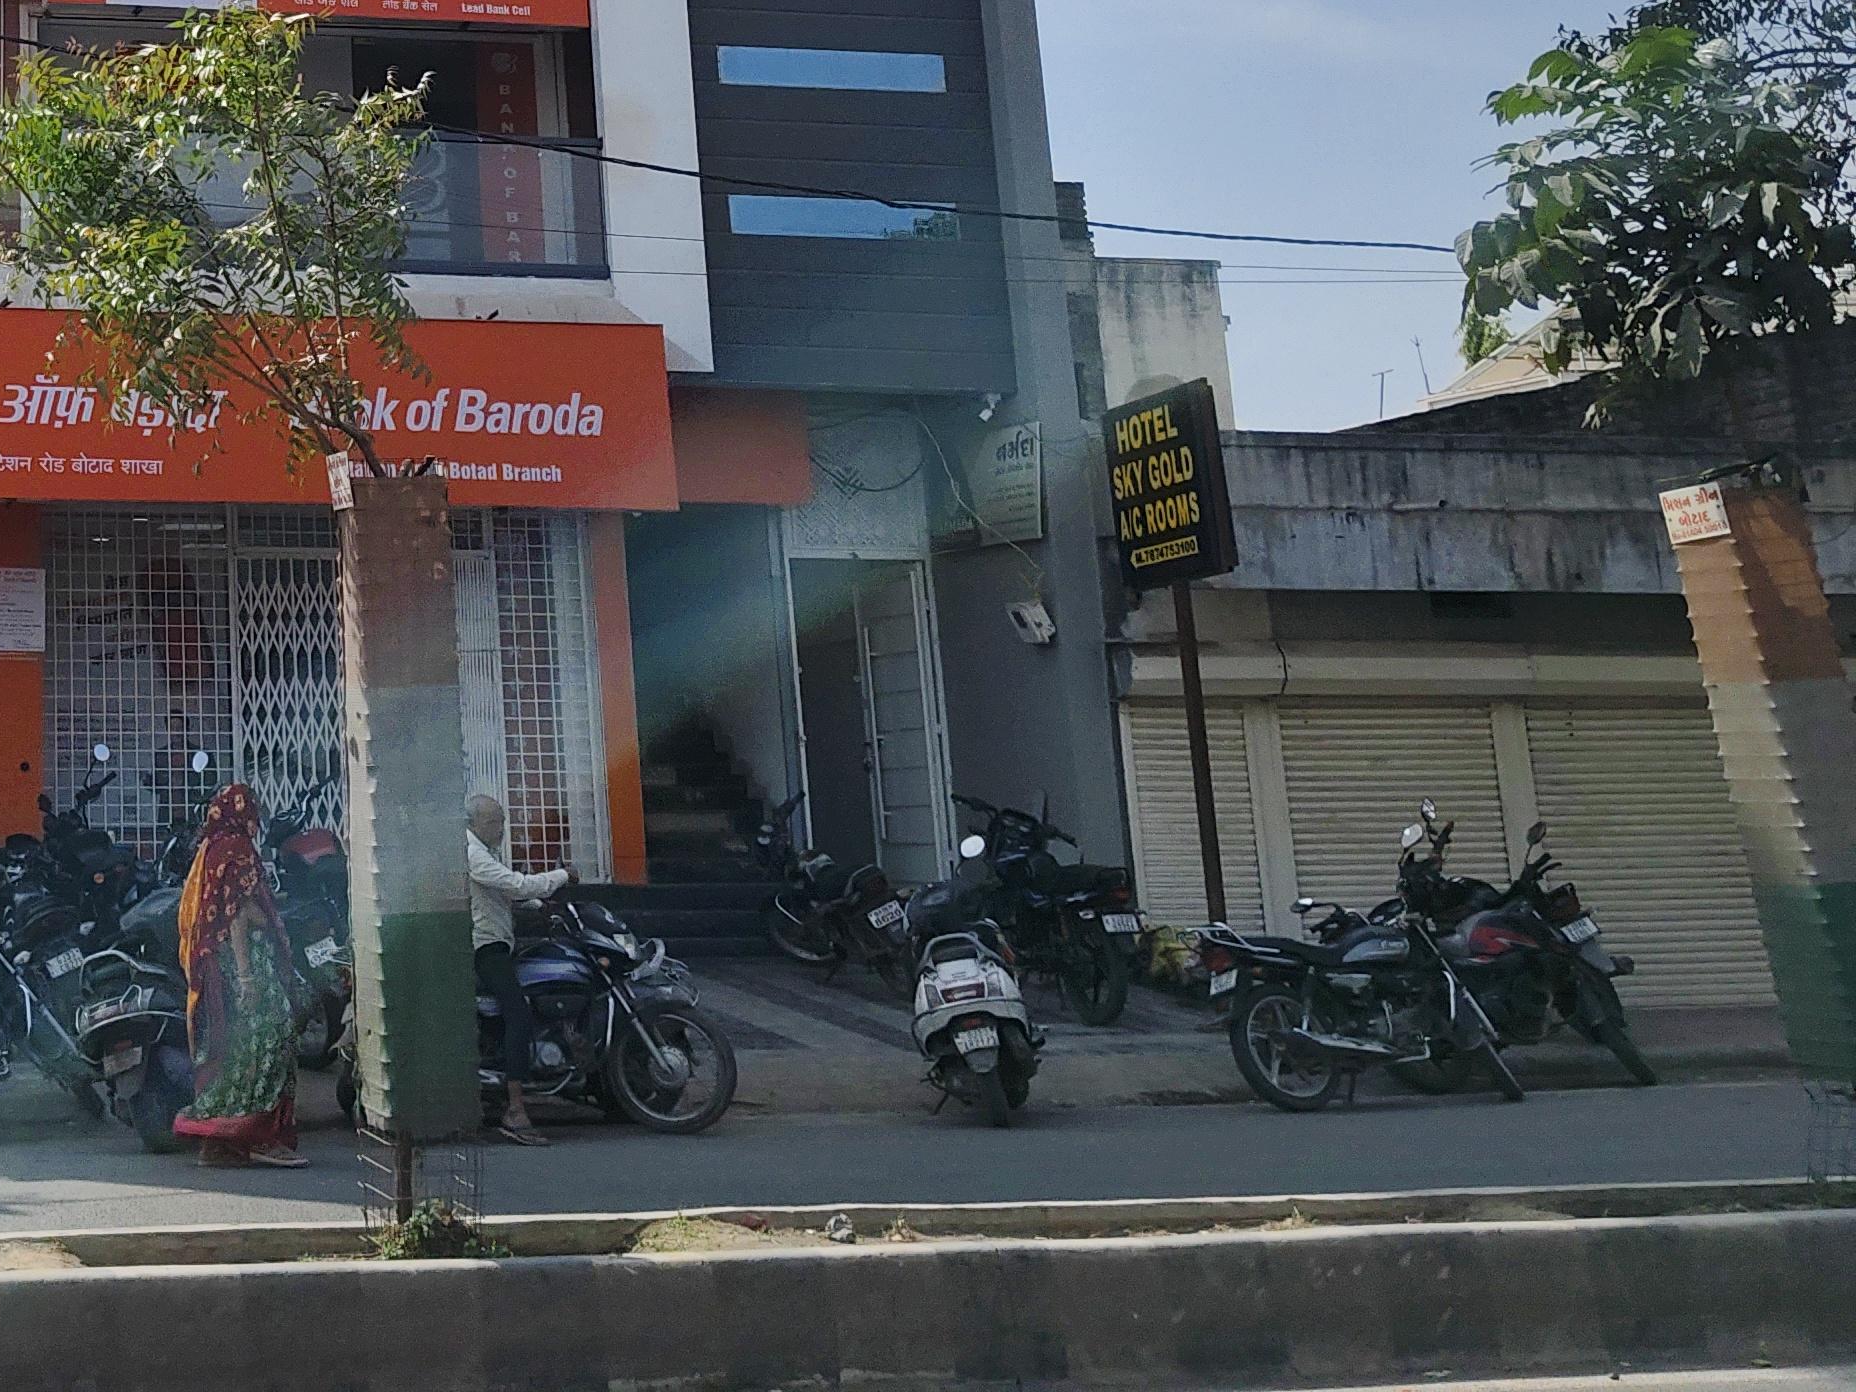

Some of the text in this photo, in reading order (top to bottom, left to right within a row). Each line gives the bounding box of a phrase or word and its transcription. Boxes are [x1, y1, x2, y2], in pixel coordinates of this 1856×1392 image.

[461, 2, 531, 16] Lead Bank Cell
[503, 167, 518, 198] OF
[506, 211, 522, 263] BAR
[405, 387, 450, 433] of
[454, 388, 604, 437] Baroda
[1115, 404, 1179, 455] HOTEL
[38, 451, 67, 474] रोड
[71, 452, 115, 476] बोटाद
[120, 457, 164, 477] शाखा
[449, 461, 497, 482] Botad
[502, 462, 562, 483] Branch
[1113, 445, 1194, 500] SKY GOLD
[1120, 490, 1200, 542] A/C ROOMS
